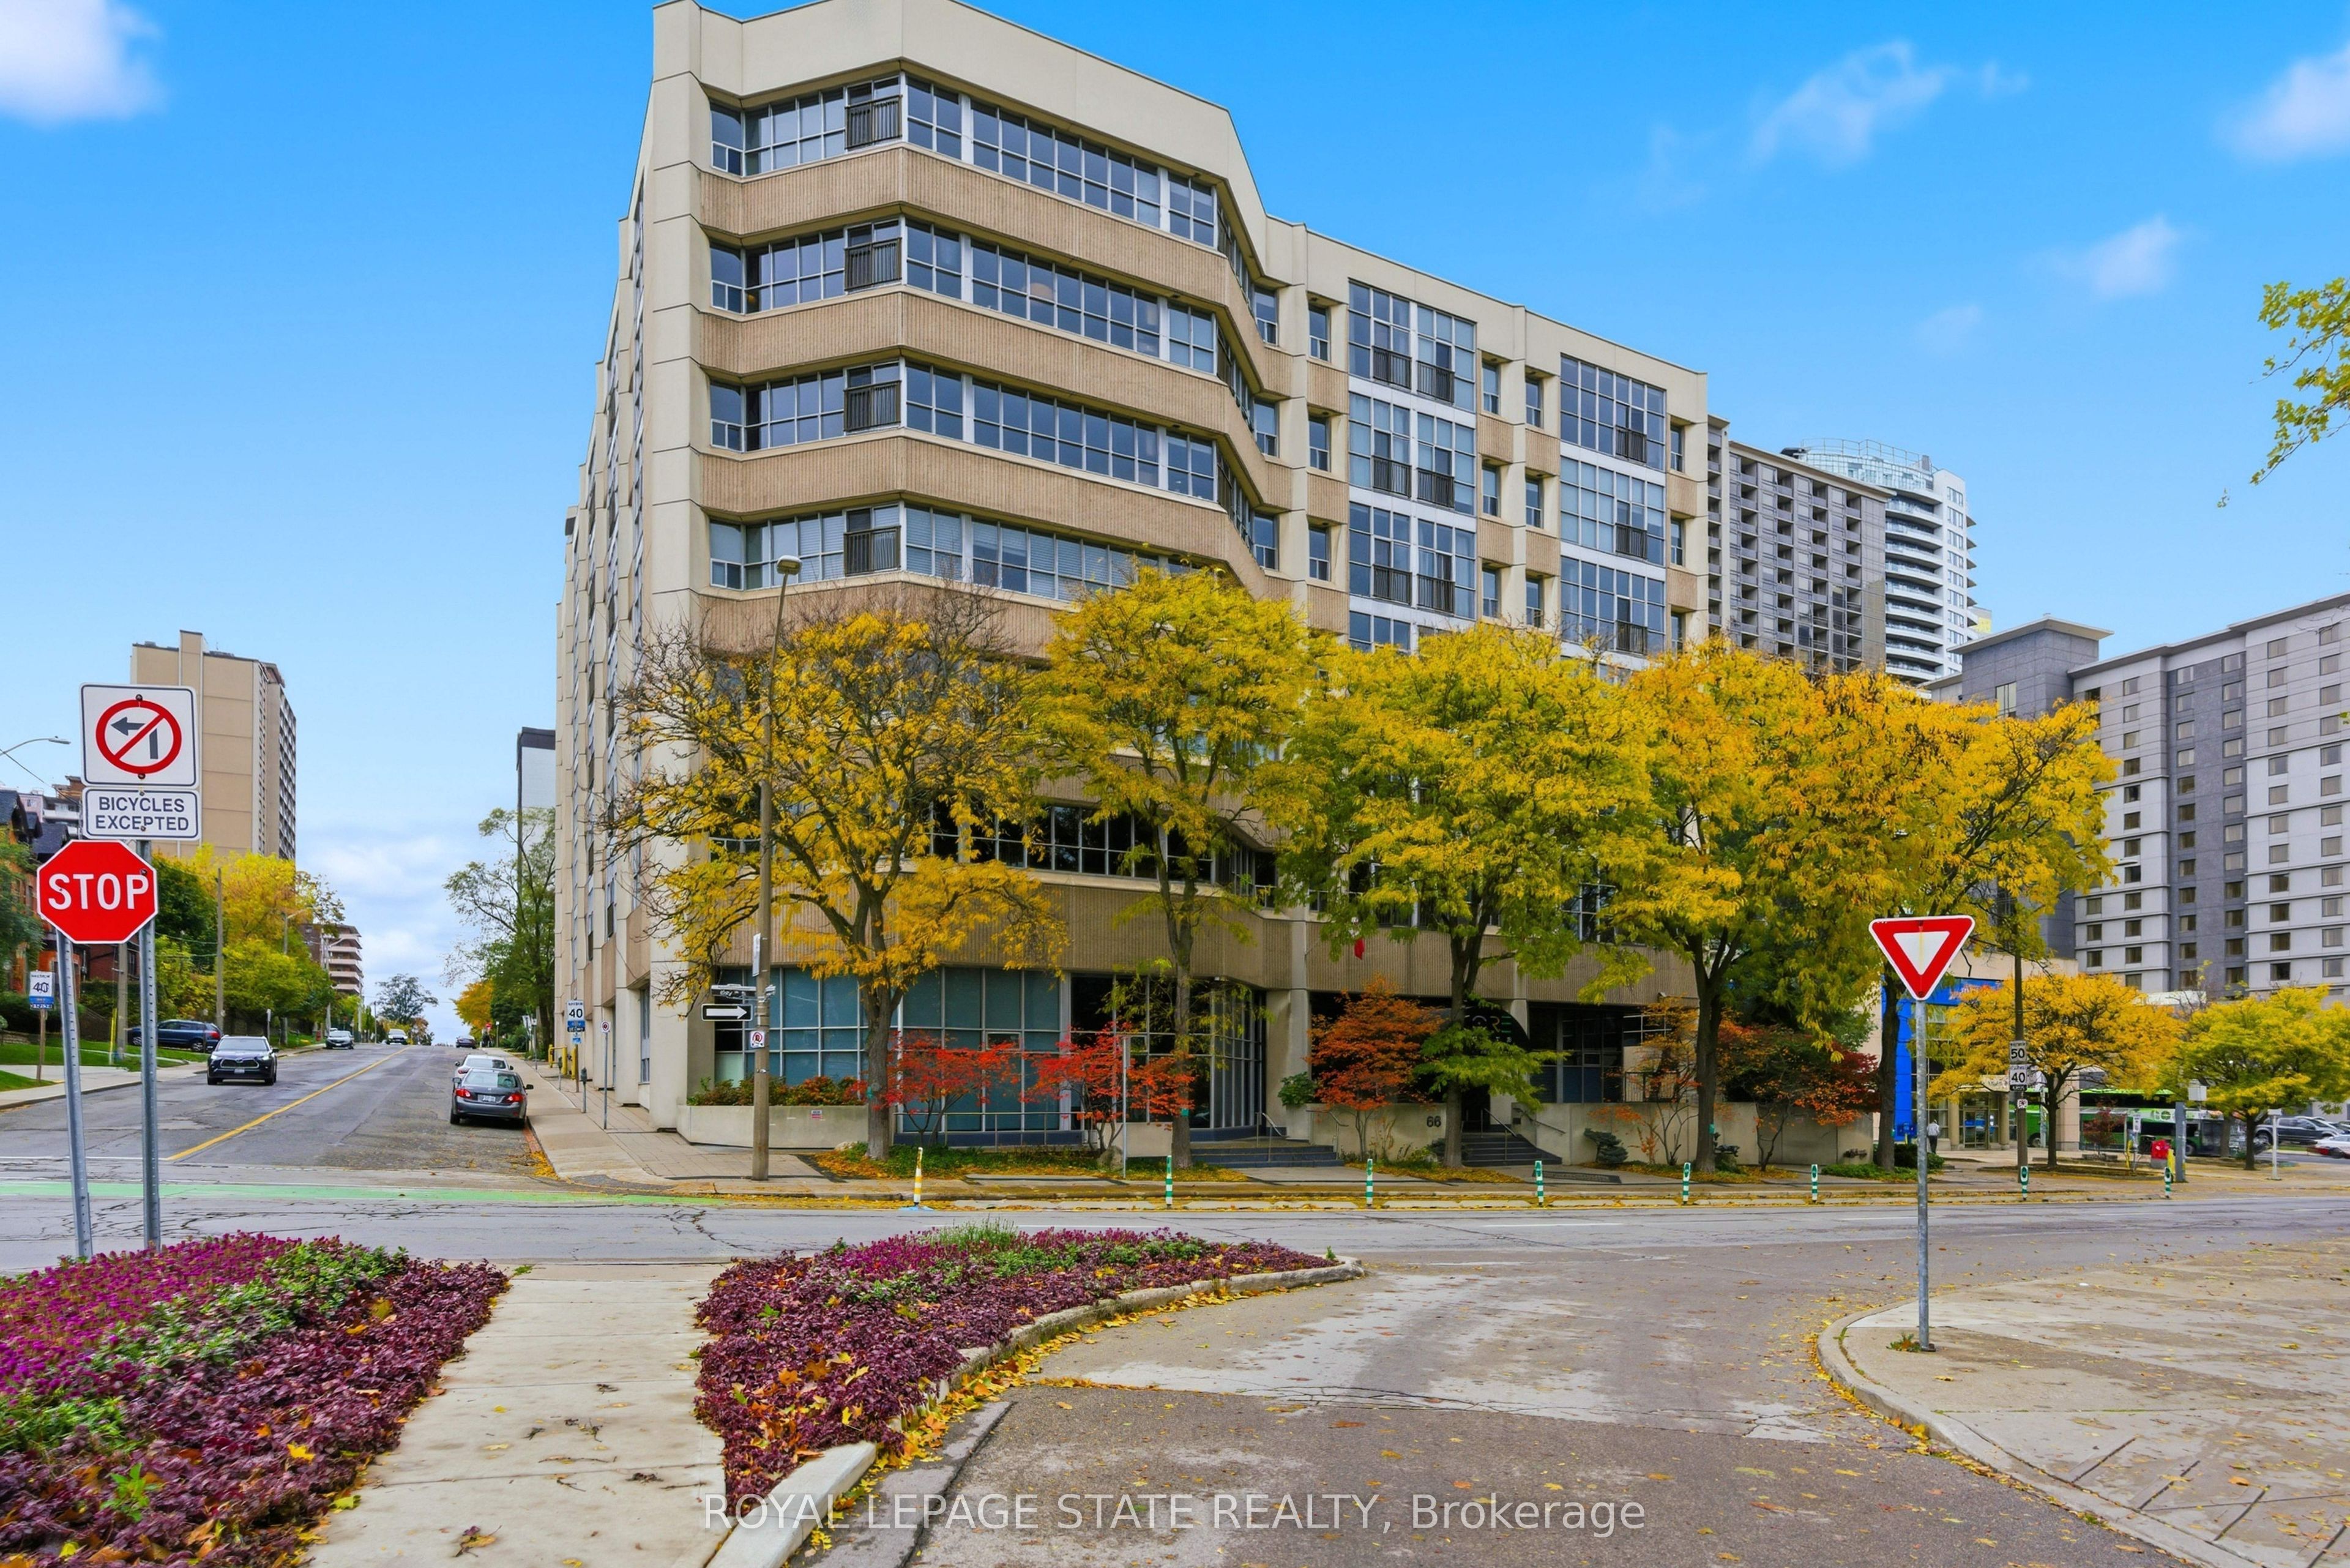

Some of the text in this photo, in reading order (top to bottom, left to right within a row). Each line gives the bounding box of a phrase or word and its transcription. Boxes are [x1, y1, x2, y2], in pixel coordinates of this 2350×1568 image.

[99, 796, 185, 812] BICYCLES
[95, 815, 189, 831] EXCEPTED
[48, 873, 149, 910] STOP
[32, 982, 49, 993] 40
[569, 1008, 583, 1018] 40
[2011, 1048, 2025, 1059] 50
[2012, 1072, 2026, 1083] 40
[1427, 1116, 1441, 1127] 66
